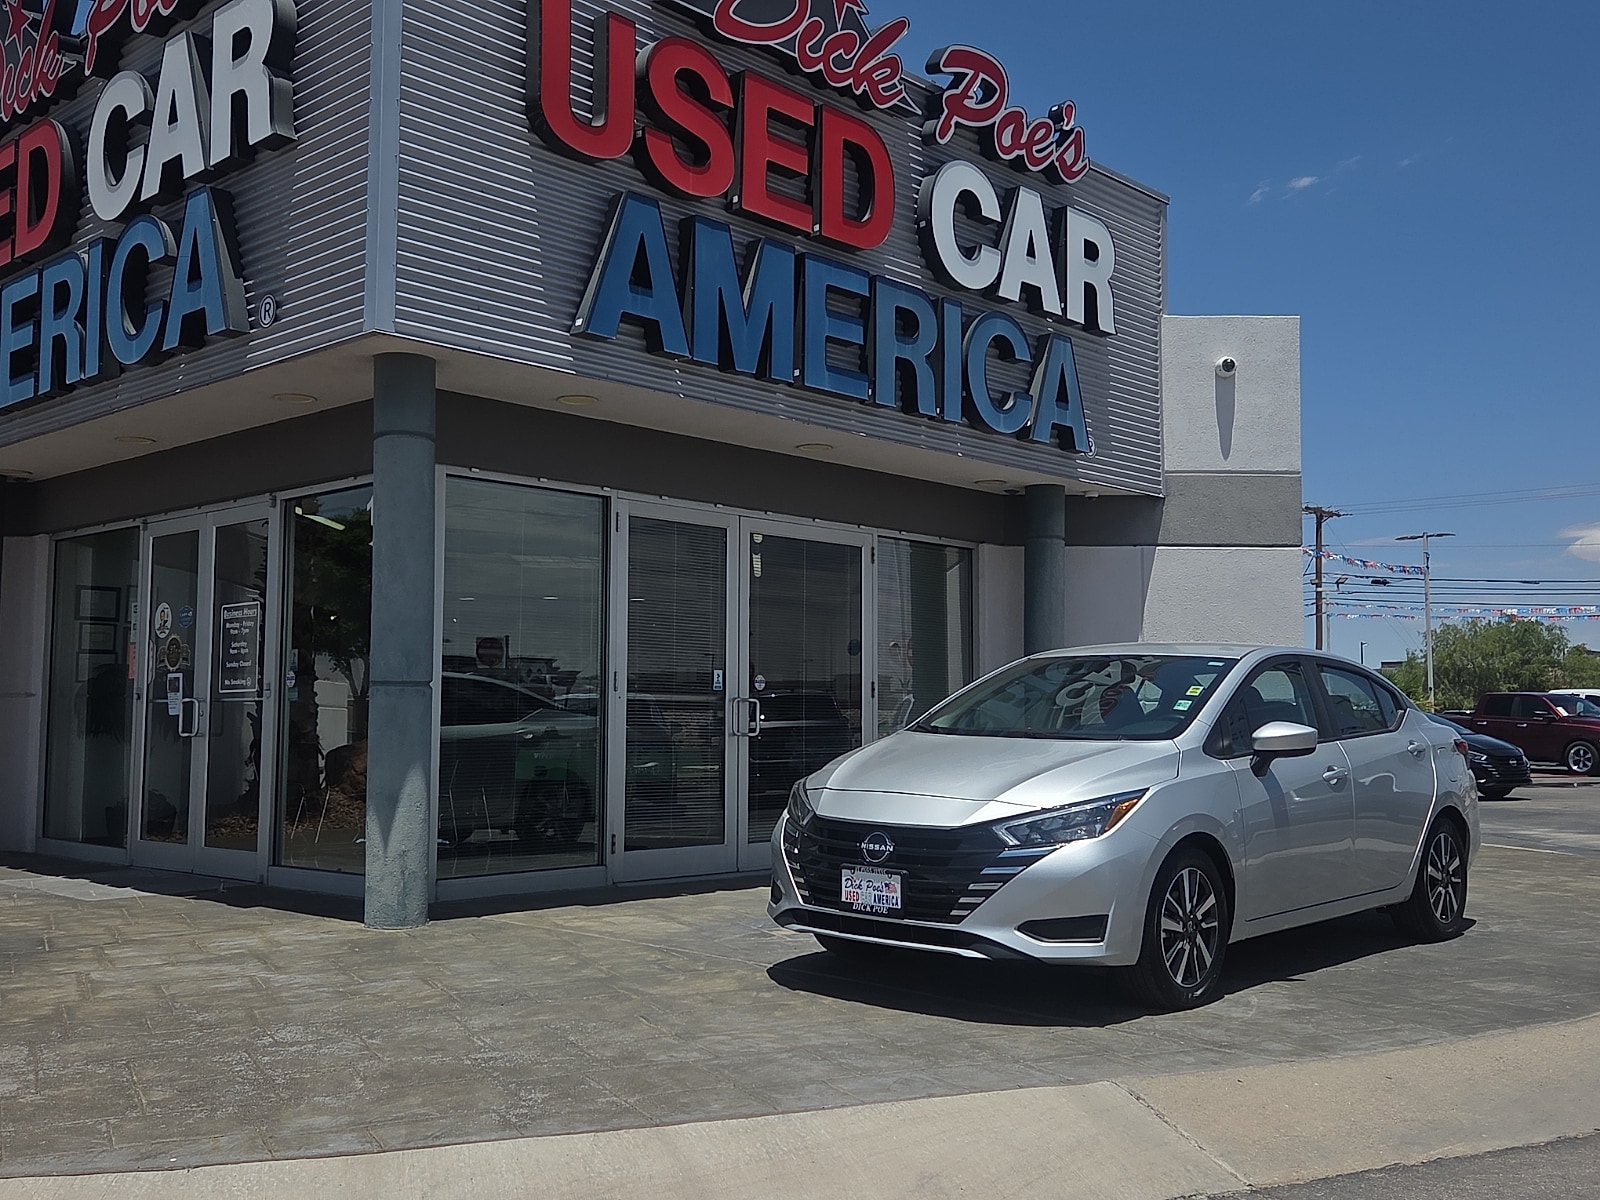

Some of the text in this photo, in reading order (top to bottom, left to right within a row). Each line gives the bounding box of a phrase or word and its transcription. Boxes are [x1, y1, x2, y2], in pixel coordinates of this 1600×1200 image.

[87, 0, 275, 221] CAR
[541, 0, 895, 250] USED
[935, 44, 1090, 184] Poe's
[931, 160, 1117, 335] CAR
[585, 197, 1090, 454] AMERICA
[844, 877, 863, 891] Dick
[844, 890, 860, 902] USED
[873, 893, 899, 907] AMERICA
[852, 903, 889, 914] DICK POE
[861, 842, 894, 852] NISSAN
